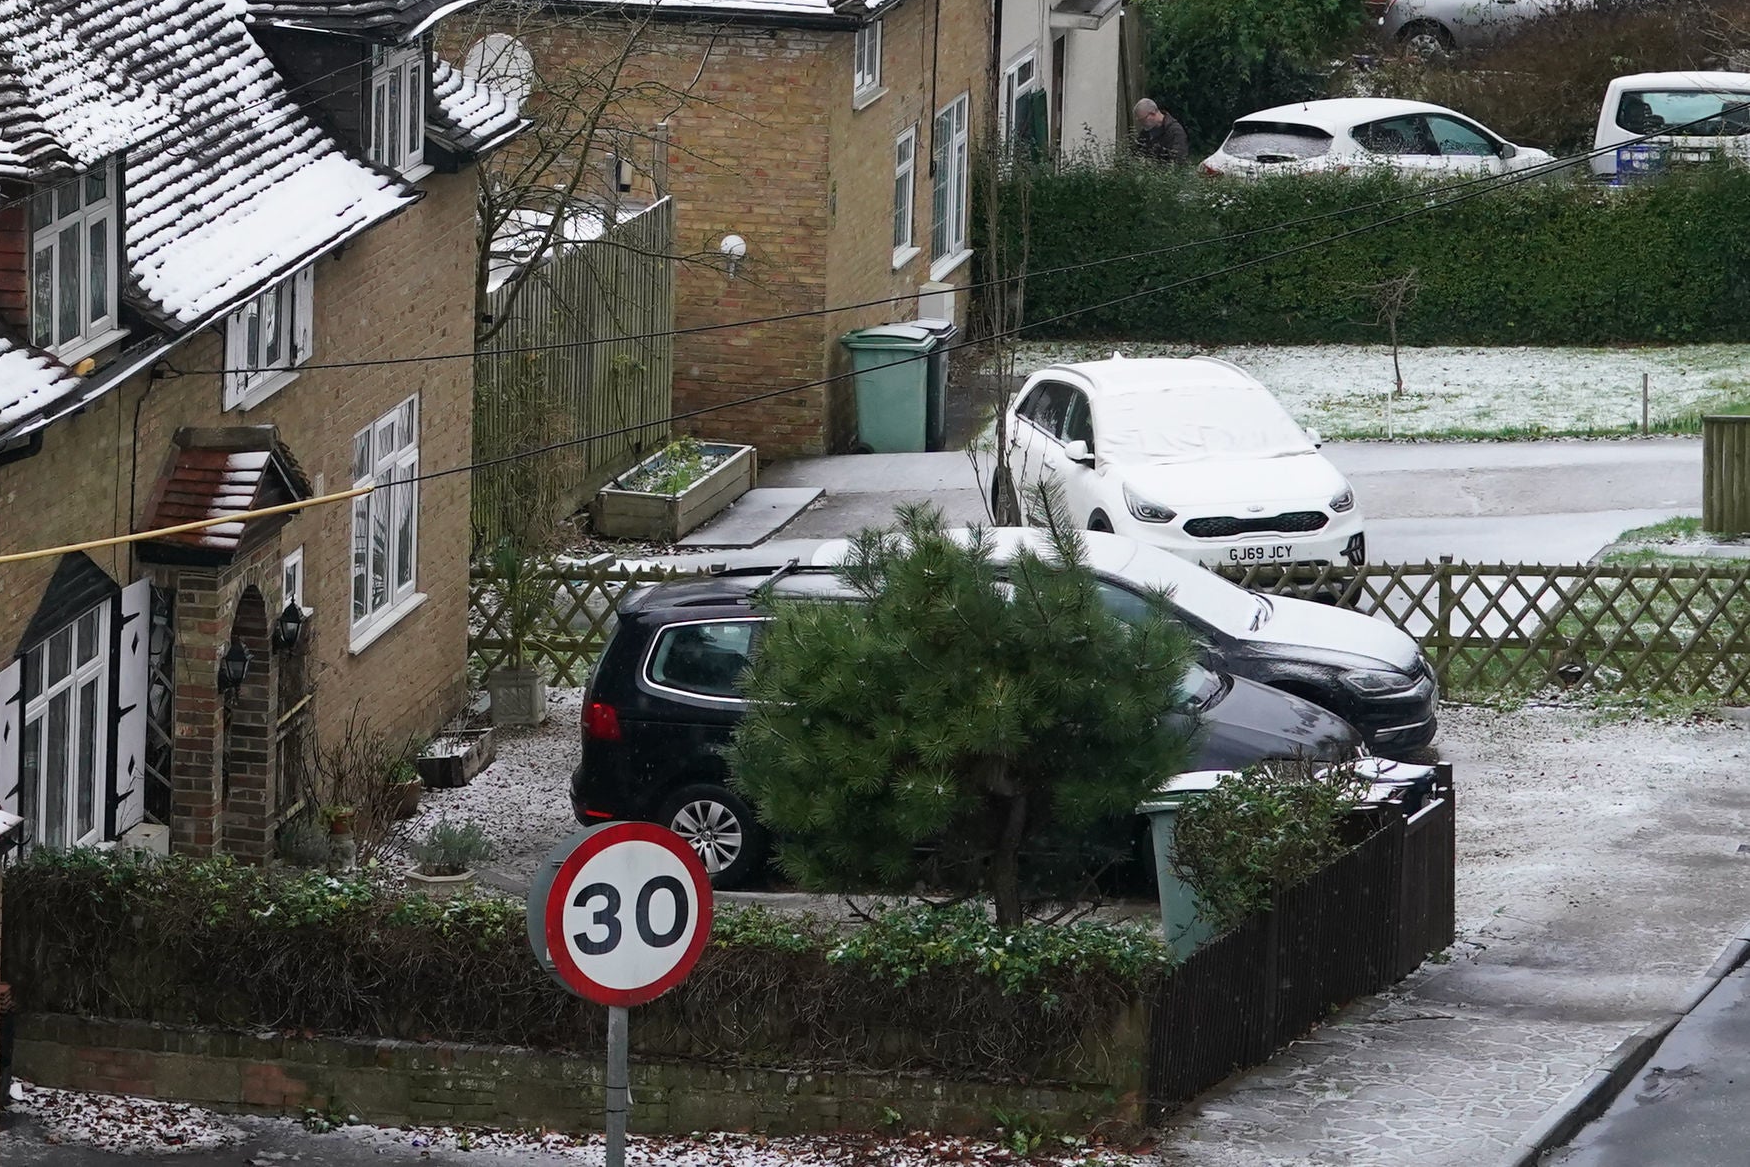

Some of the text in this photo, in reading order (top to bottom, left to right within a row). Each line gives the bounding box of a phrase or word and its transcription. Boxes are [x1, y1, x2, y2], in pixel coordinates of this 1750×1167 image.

[1229, 545, 1293, 561] GJ69 JCY
[573, 875, 689, 956] 30
